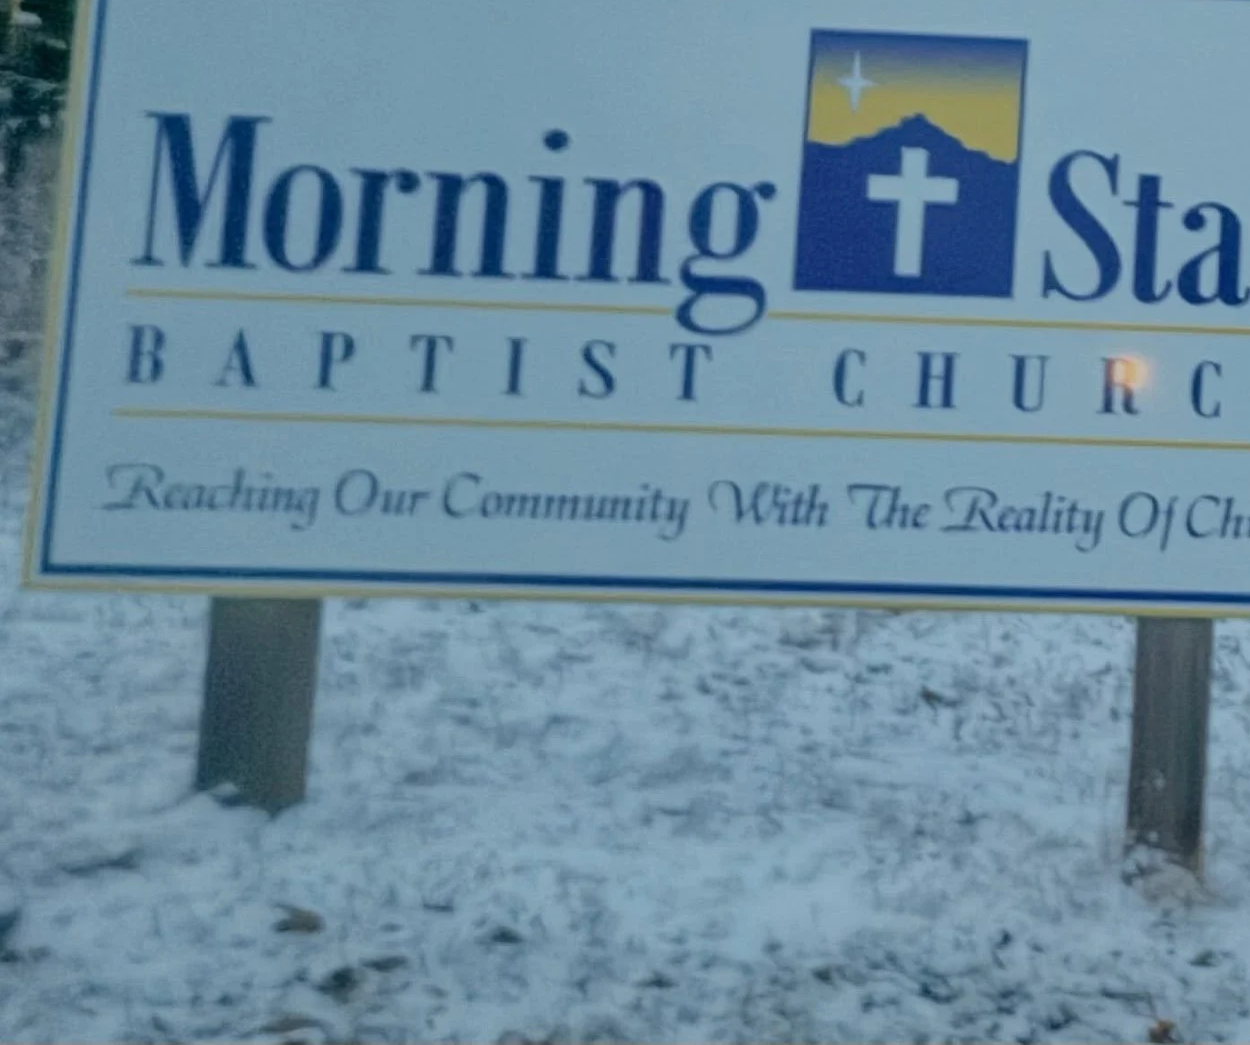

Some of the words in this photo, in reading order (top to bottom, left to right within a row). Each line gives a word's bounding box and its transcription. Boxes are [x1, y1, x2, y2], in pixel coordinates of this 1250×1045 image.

[129, 110, 777, 336] Morning
[125, 324, 714, 402] BAPTIST
[100, 461, 321, 531] Reaching
[334, 468, 431, 517] Our
[441, 471, 691, 541] Community
[707, 479, 830, 527] With
[847, 483, 931, 531] The
[938, 485, 1105, 553] Reality
[1117, 490, 1178, 553] Of
